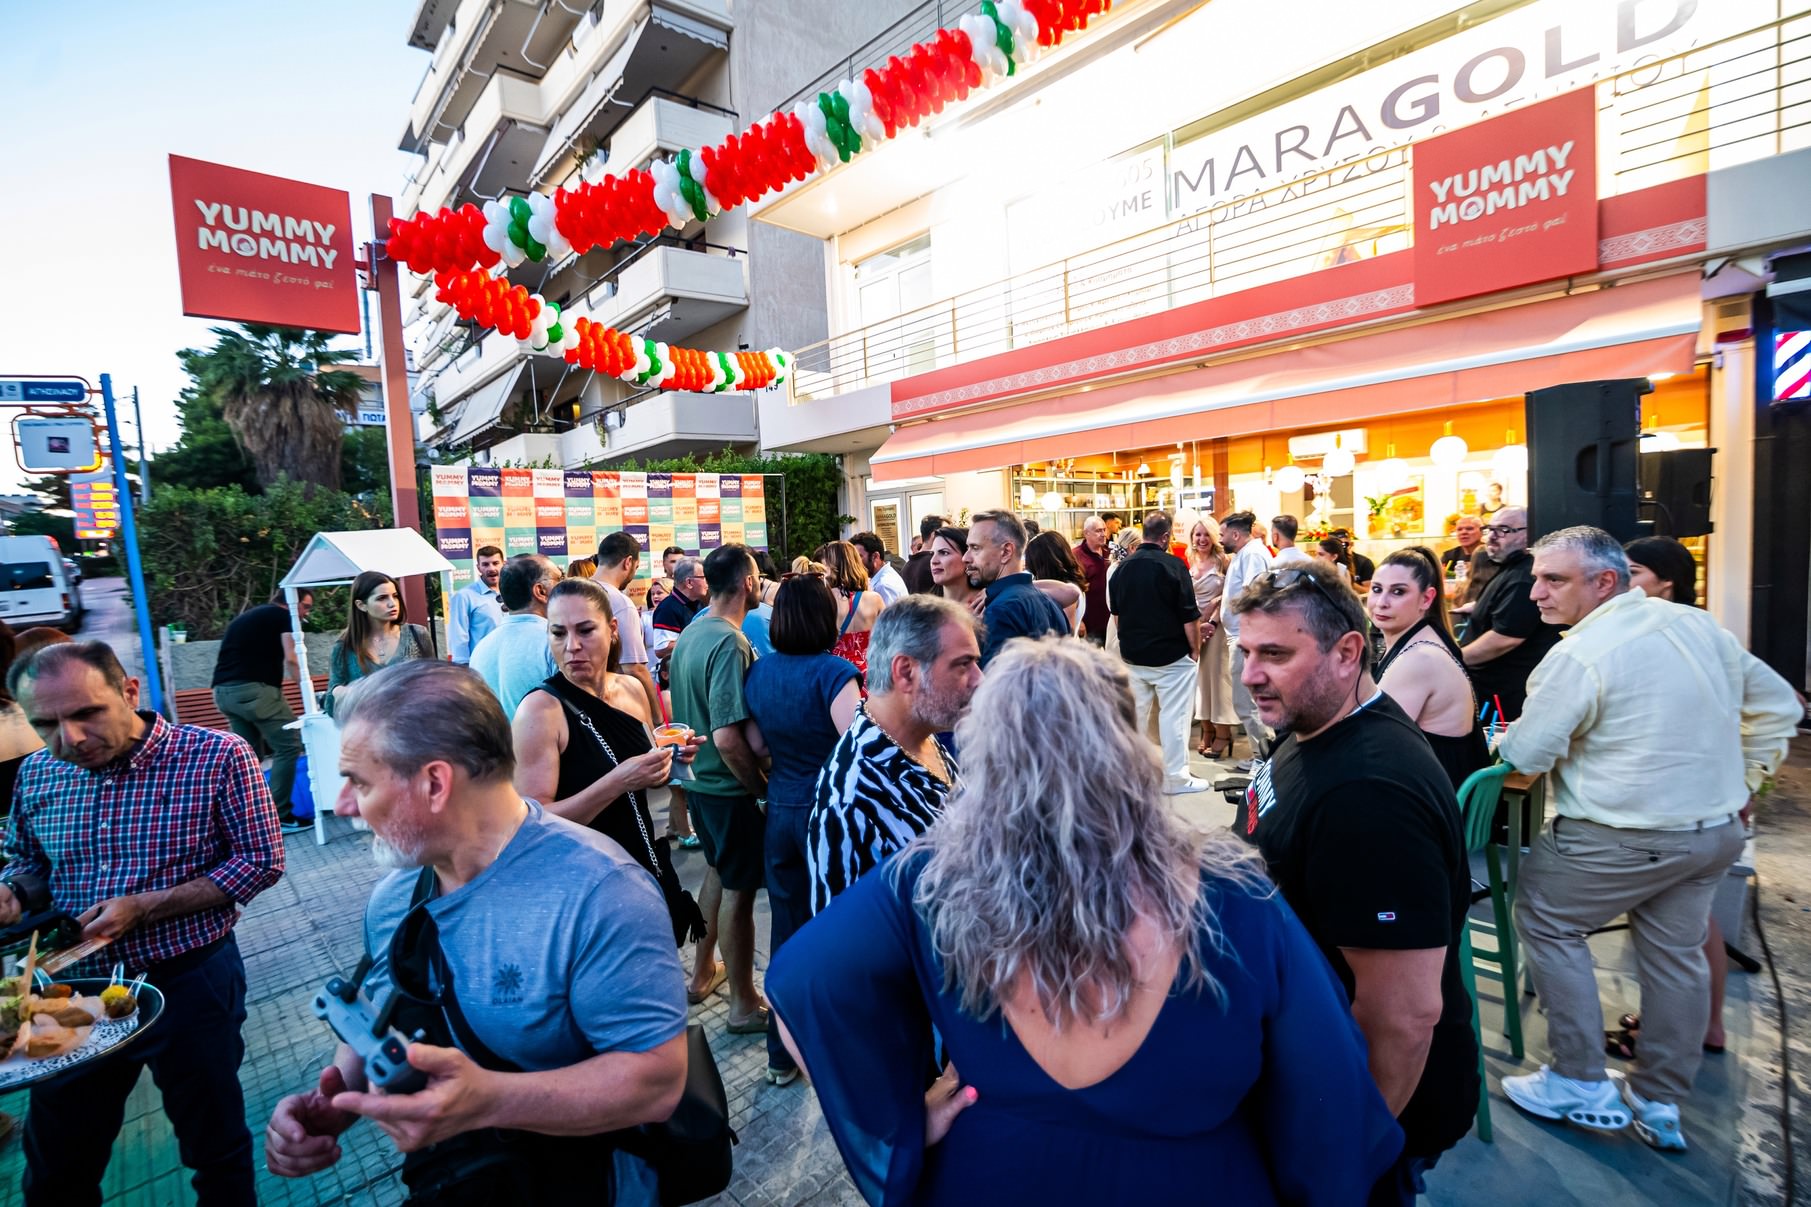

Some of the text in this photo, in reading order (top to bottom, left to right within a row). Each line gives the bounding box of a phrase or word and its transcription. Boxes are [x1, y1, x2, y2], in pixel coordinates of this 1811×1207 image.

[1174, 0, 1698, 209] MARAGOLD
[1429, 140, 1575, 203] YUMMY
[1430, 169, 1575, 230] MOMMY
[194, 199, 336, 246] YUMMY
[198, 227, 338, 270] MOMMY
